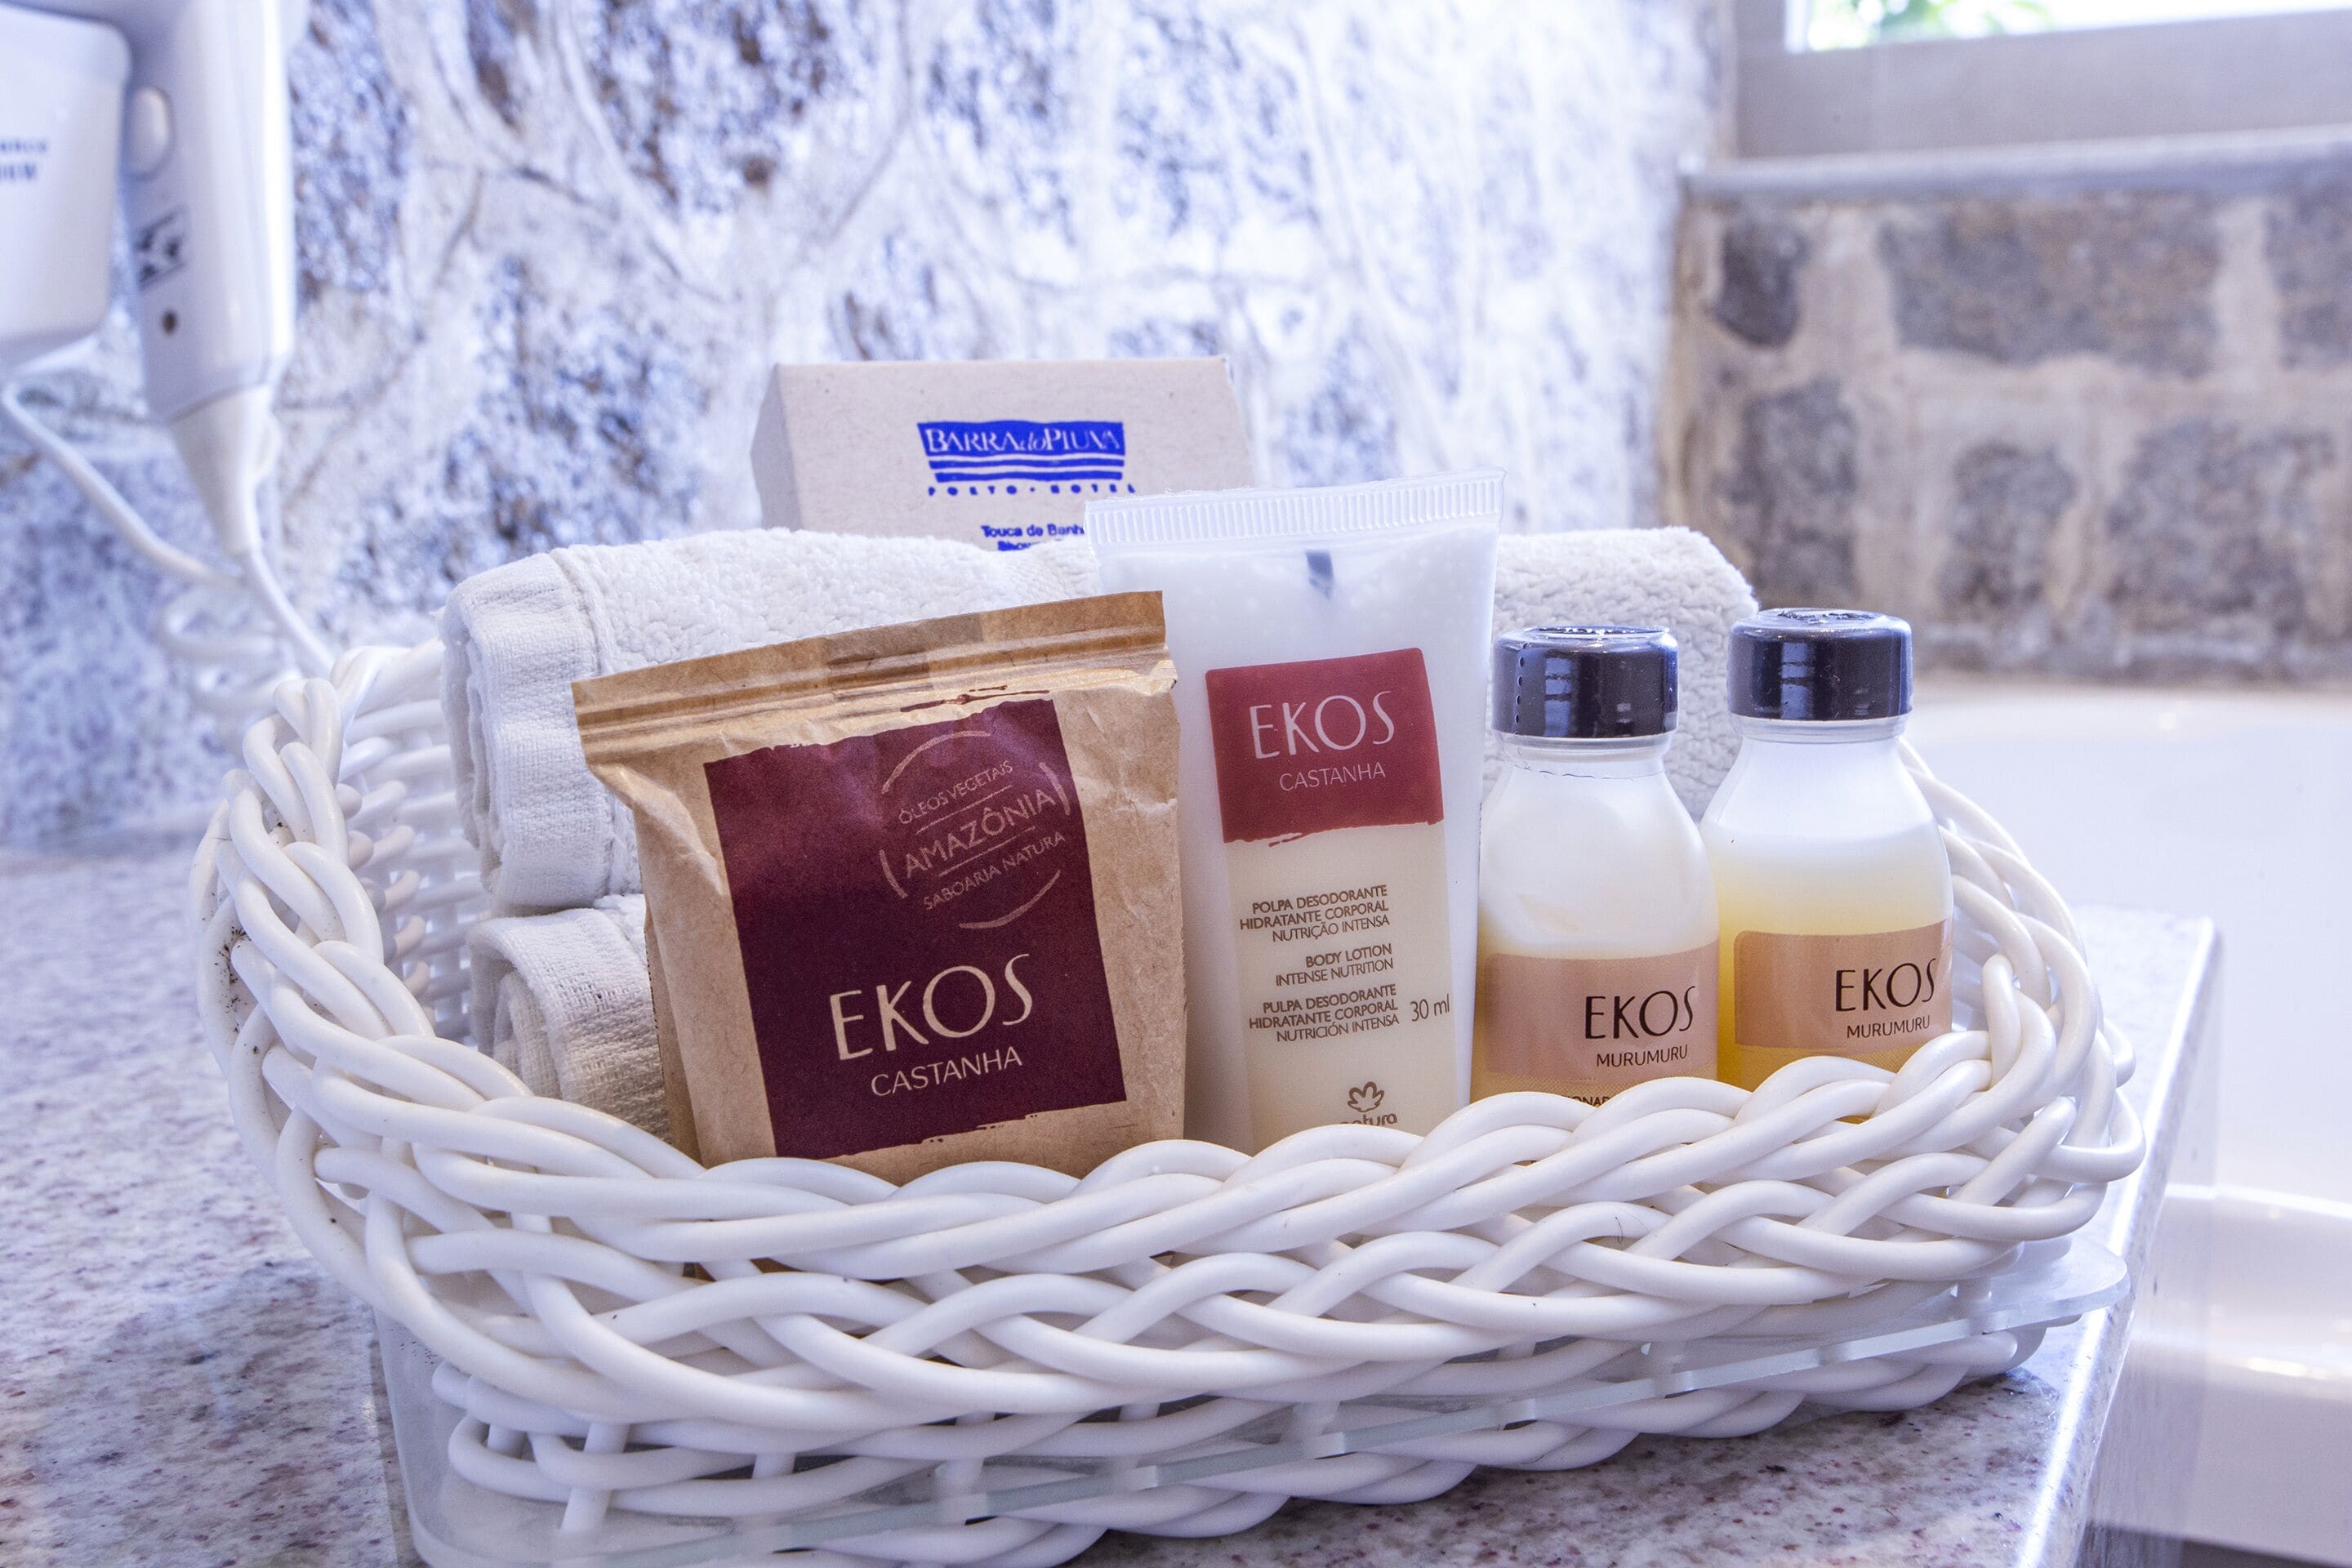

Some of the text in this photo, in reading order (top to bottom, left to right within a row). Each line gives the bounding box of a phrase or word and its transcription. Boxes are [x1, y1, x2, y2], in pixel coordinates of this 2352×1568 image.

[925, 427, 1021, 452] BARRA
[980, 524, 1022, 537] Touca
[1250, 690, 1395, 760] EKOS
[947, 760, 1013, 800] VEGETAIS
[1279, 761, 1386, 791] CASTANHA
[905, 788, 1057, 879] AMAZÔNIA
[924, 831, 1066, 911] SABOARIA NATURA
[1240, 899, 1389, 930] HIDRATANTE CORPORAL
[1252, 884, 1388, 915] POLPA DESODORANTE
[1272, 913, 1390, 943] NUTRIÇÃO INTENSA
[1305, 942, 1392, 969] BODY LOTION
[1276, 957, 1394, 987] INTENSE NUTRITION
[1834, 957, 1937, 1013] EKOS
[830, 953, 1033, 1060] EKOS
[1249, 998, 1399, 1030] HIDRATANTE CORPORAL
[1263, 983, 1396, 1014] PULPA DESODORANTE
[1410, 993, 1450, 1022] 30 ml
[1584, 985, 1696, 1040] EKOS
[1276, 1013, 1400, 1043] NUTRICIÓN INTENSA
[1846, 1015, 1931, 1040] MURUMURU
[871, 1046, 1022, 1096] CASTANHA
[1596, 1044, 1688, 1068] MURUMURU
[1339, 1112, 1398, 1127] tura
